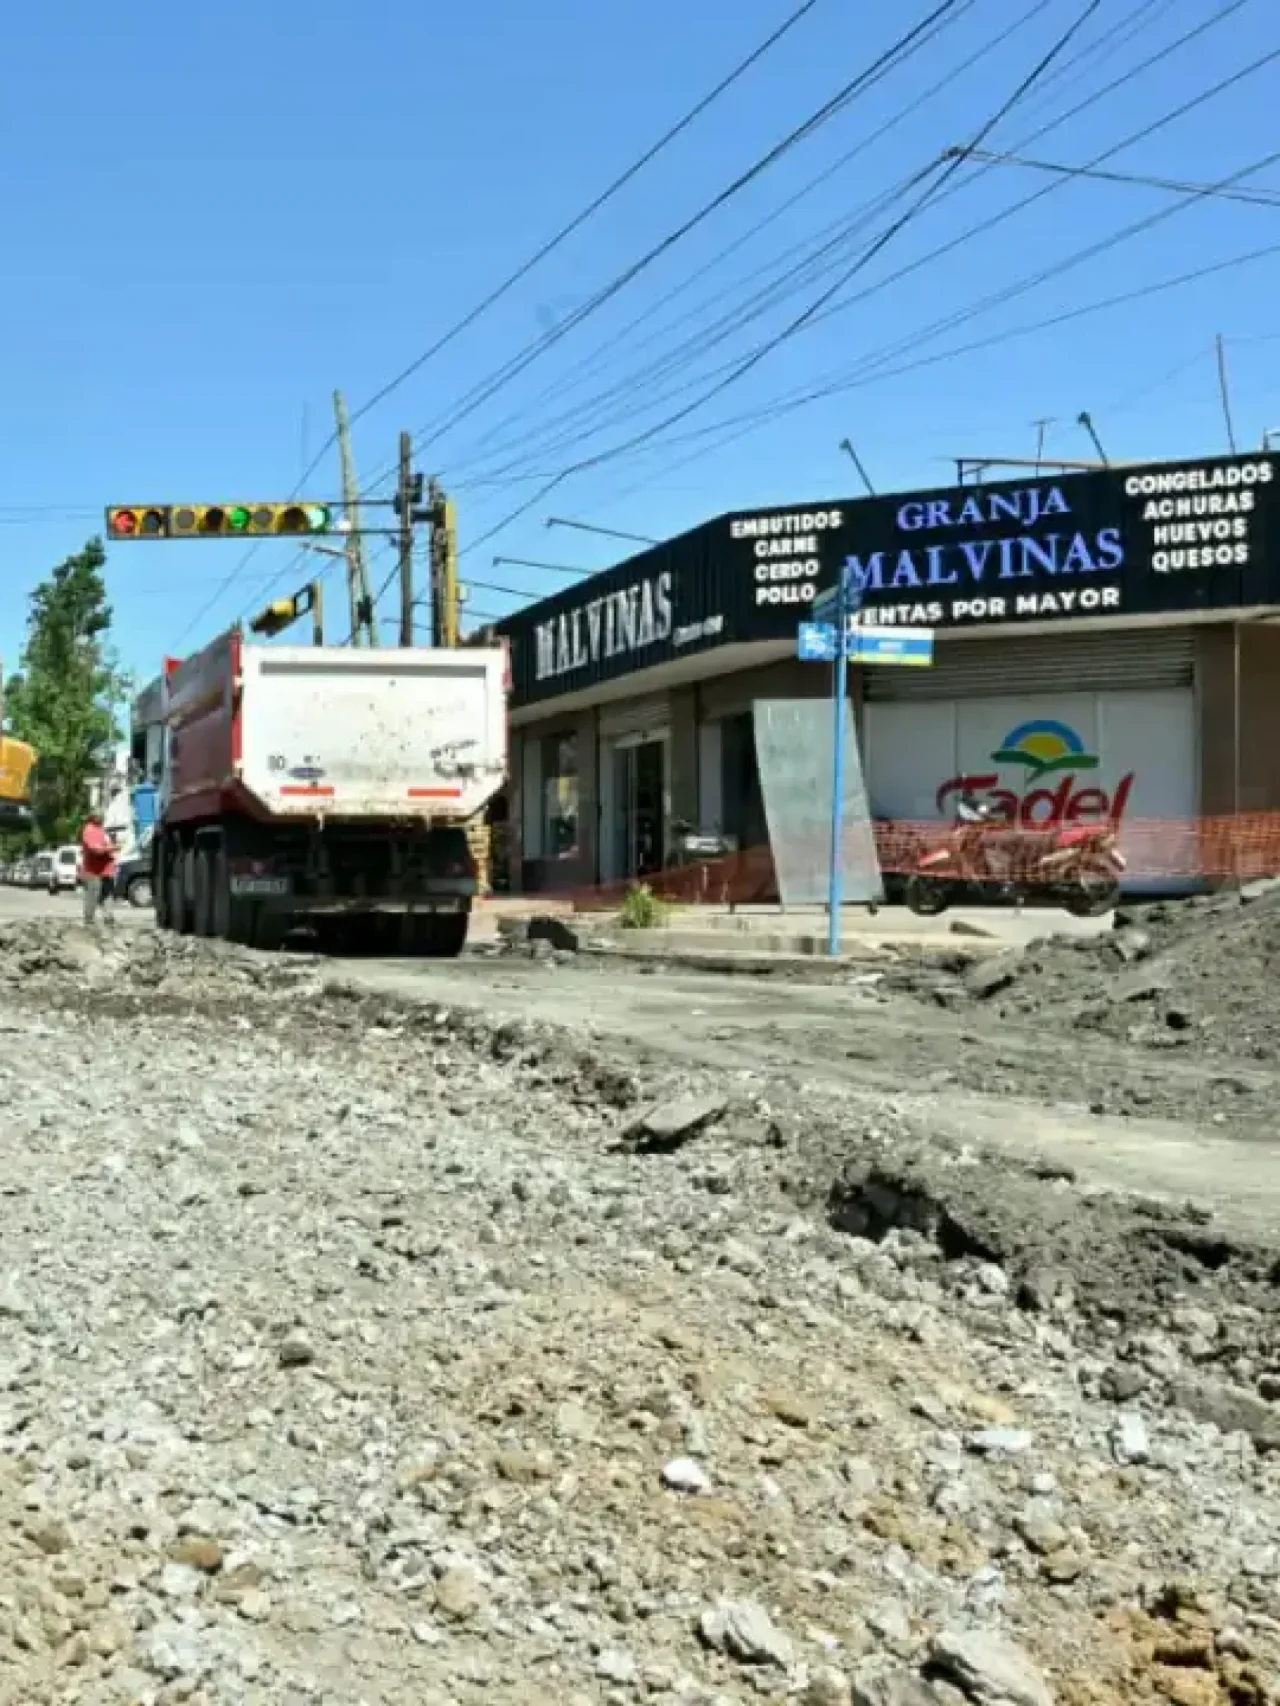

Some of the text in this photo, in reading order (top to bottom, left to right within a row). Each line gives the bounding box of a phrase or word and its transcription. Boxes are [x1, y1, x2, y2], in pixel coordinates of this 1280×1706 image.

[1125, 461, 1273, 496] CONGELADOS
[896, 486, 1071, 531] GRANJA
[1142, 490, 1255, 520] ACHURAS
[730, 509, 844, 538] EMBUTIDOS
[1153, 516, 1248, 546] HUEVOS
[754, 536, 818, 558] CARNE
[844, 528, 1123, 590] MALVINAS
[1152, 542, 1249, 573] QUESOS
[754, 559, 819, 582] CERDO
[754, 582, 817, 605] POLLO
[952, 597, 1006, 620] POR
[1016, 586, 1121, 614] MAYOR
[535, 571, 671, 681] MALVINAS
